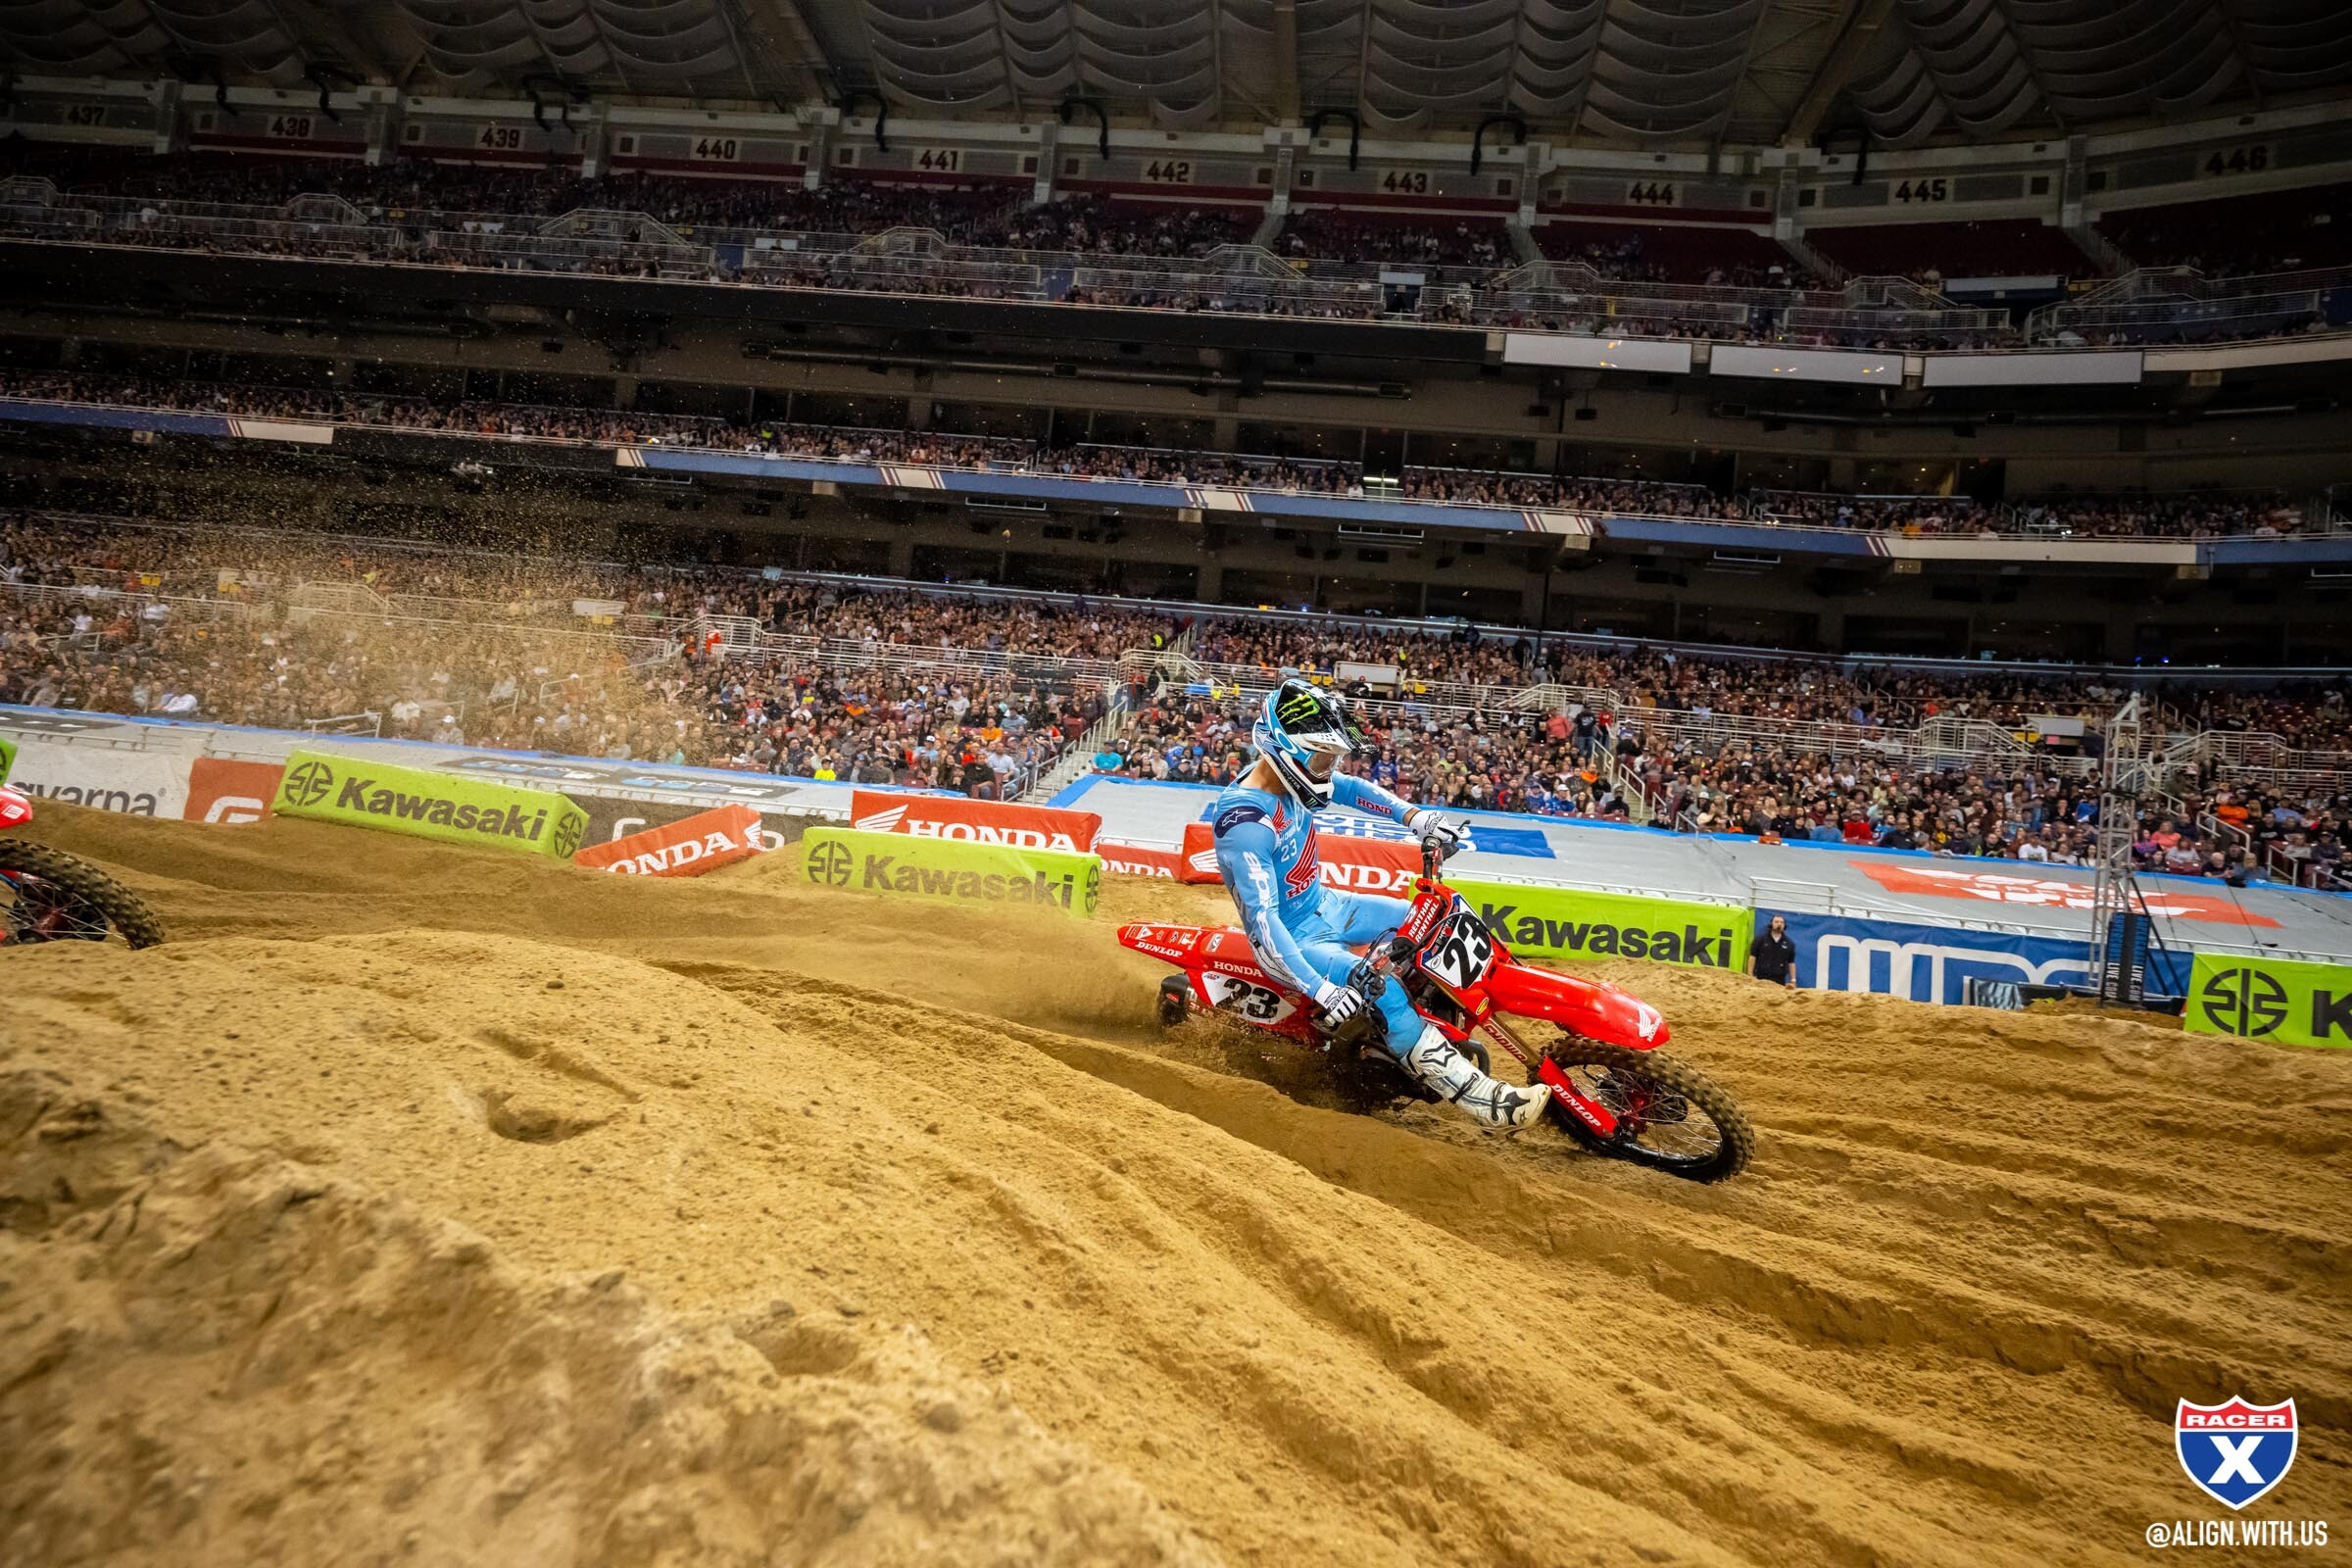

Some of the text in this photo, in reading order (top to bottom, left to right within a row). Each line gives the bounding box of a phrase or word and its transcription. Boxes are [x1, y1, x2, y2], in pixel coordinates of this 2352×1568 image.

[68, 106, 105, 126] 437
[481, 127, 520, 148] 439
[696, 139, 735, 160] 440
[919, 149, 958, 171] 441
[1148, 159, 1190, 182] 442
[2205, 145, 2268, 175] 446
[1383, 172, 1427, 194] 443
[1630, 182, 1673, 205] 444
[1895, 178, 1947, 203] 445
[336, 777, 549, 841] Kawasaki
[906, 819, 1077, 853] HONDA
[1280, 839, 1298, 862] 23
[862, 854, 1075, 909] Kawasaki
[1408, 898, 1434, 938] RENTHAL
[1415, 903, 1440, 944] RENTHAL
[1482, 904, 1734, 968] Kawasaki
[1136, 941, 1183, 958] DUNLOP
[1443, 910, 1493, 990] 23
[1214, 960, 1263, 978] HONDA
[1215, 977, 1281, 1020] 23
[1550, 1083, 1602, 1127] DUNLOP
